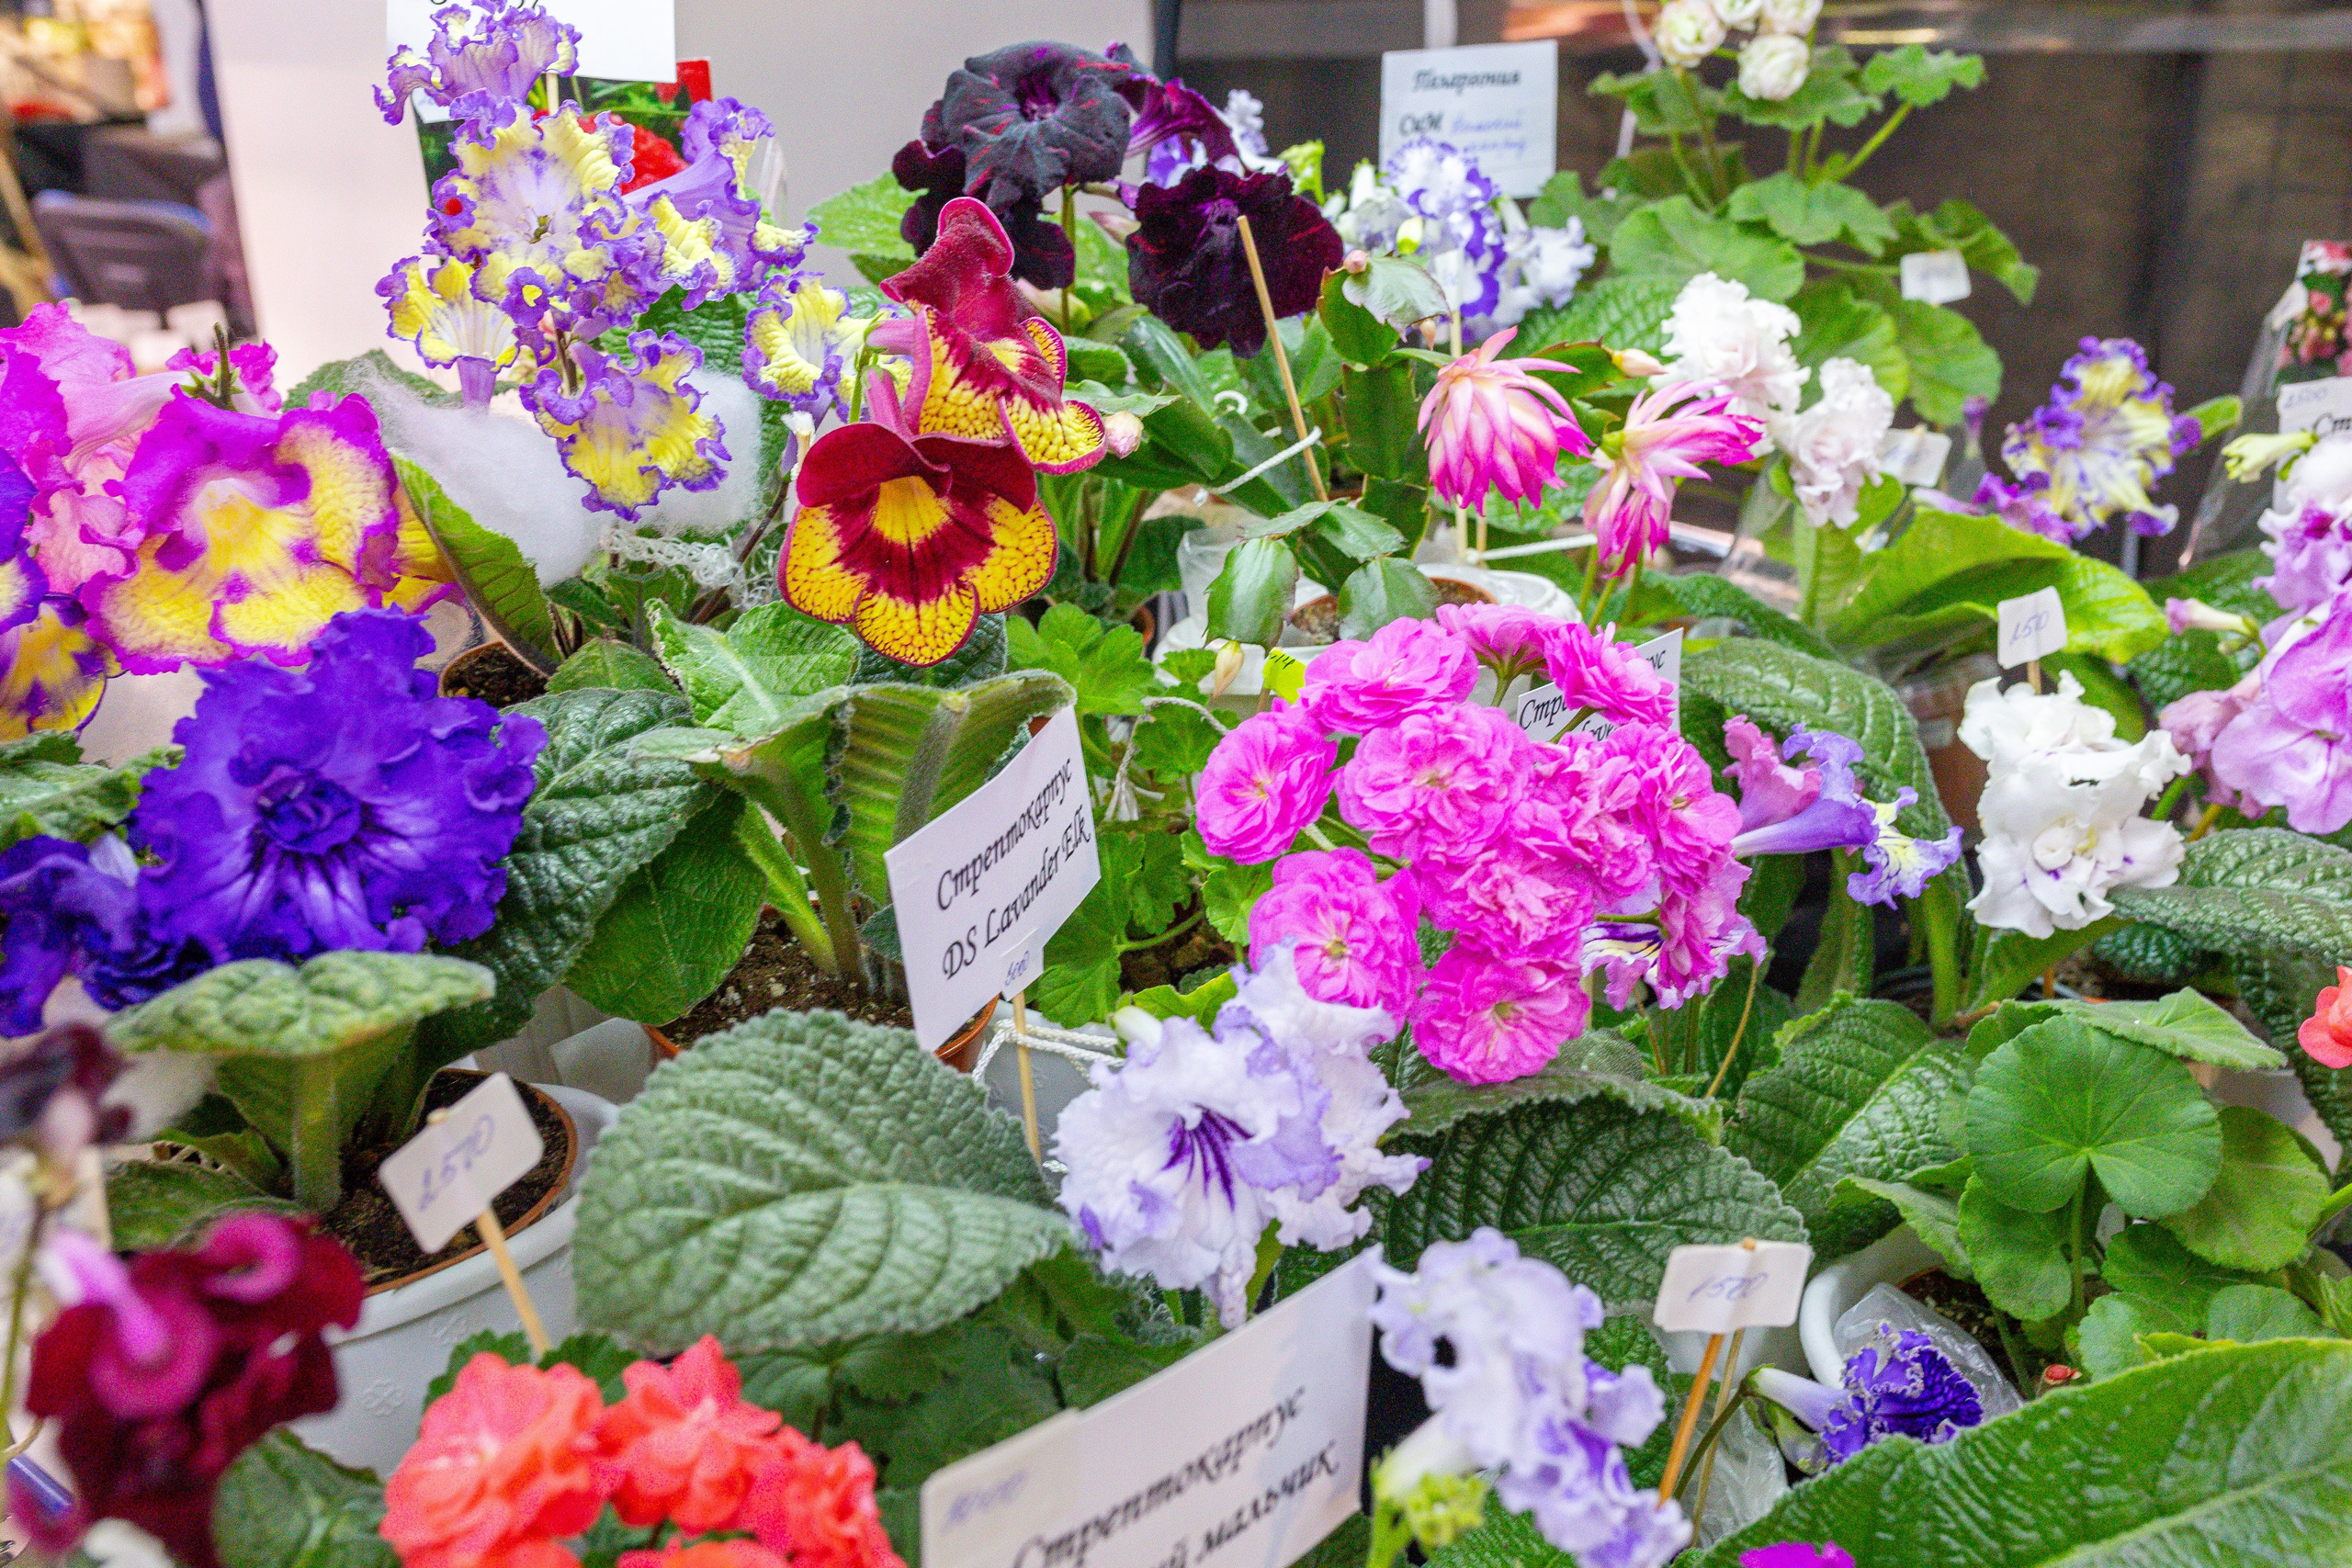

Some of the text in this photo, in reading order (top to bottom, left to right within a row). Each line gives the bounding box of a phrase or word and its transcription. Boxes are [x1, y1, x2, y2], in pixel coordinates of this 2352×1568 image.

[937, 758, 1072, 911] Стрептокарпус
[943, 927, 977, 980] DS
[984, 846, 1060, 949] Lavander
[1012, 1386, 1306, 1568] Стрептокарпус
[1198, 1439, 1341, 1560] мальчик
